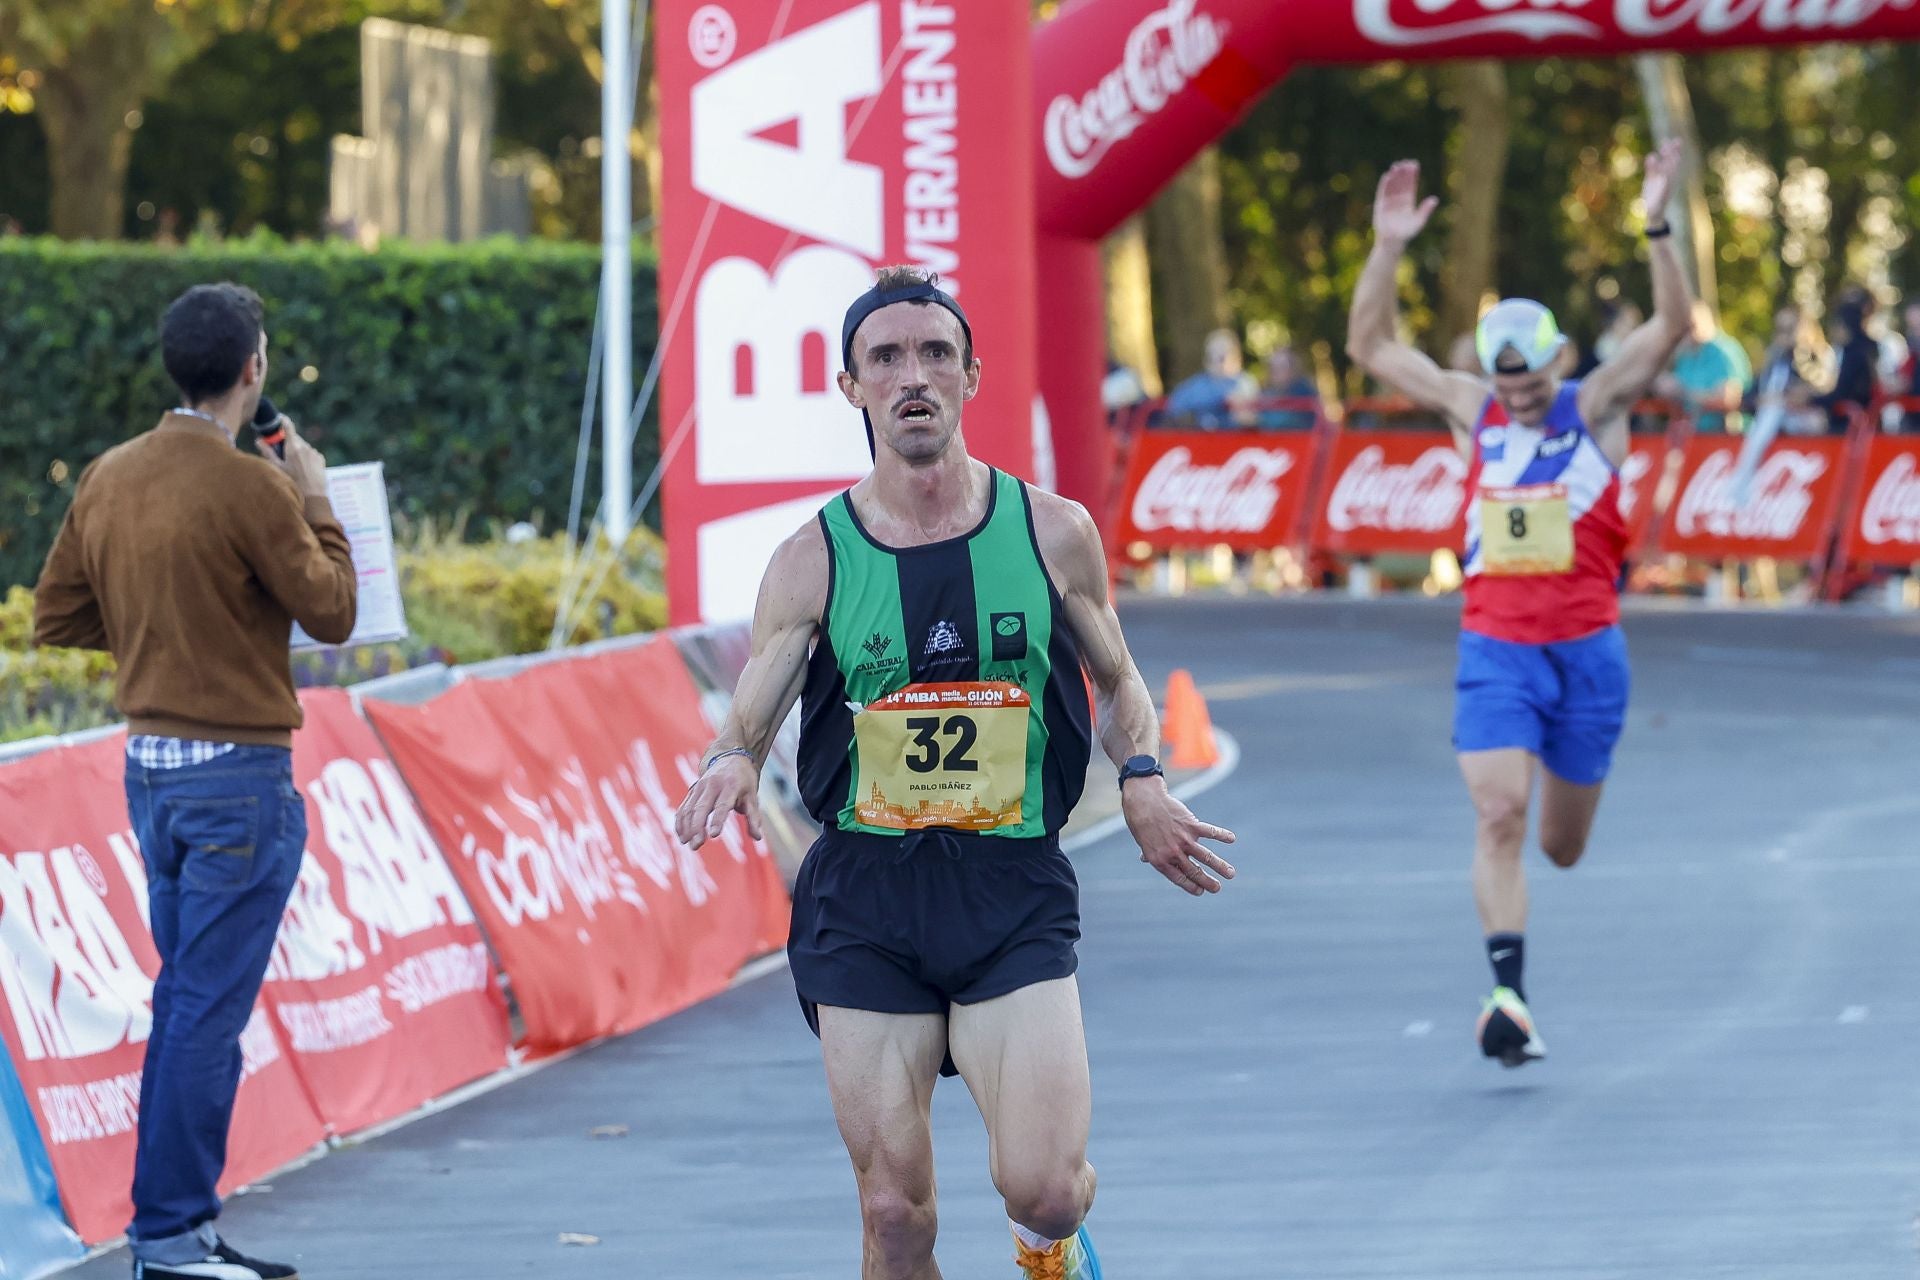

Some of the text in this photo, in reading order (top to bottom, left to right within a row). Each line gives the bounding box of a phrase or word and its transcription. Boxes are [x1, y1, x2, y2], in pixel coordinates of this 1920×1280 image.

[1509, 507, 1527, 538] 8
[904, 692, 940, 703] MBA
[967, 689, 1003, 701] GIJÓN
[905, 715, 978, 774] 32
[939, 781, 972, 790] IBÁÑEZ
